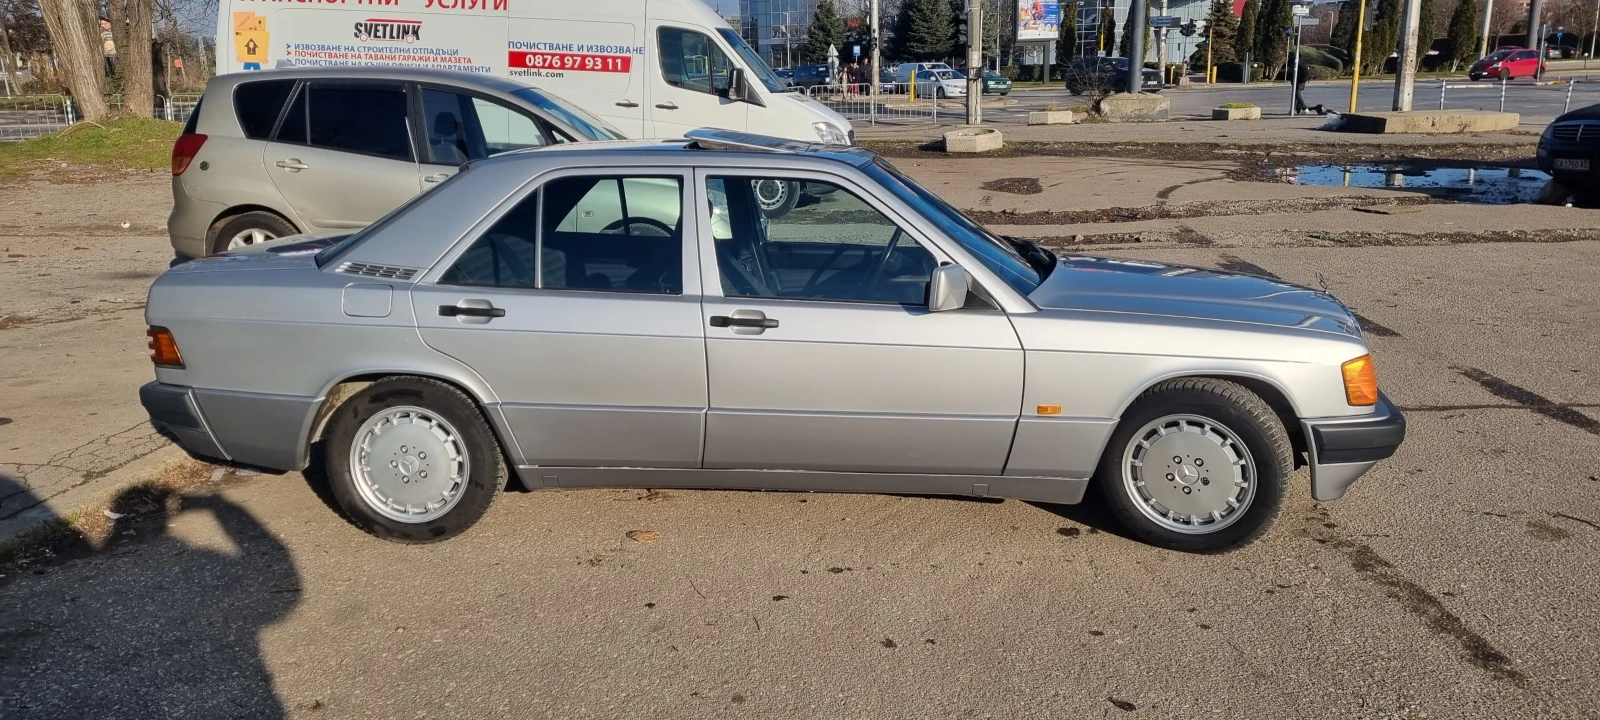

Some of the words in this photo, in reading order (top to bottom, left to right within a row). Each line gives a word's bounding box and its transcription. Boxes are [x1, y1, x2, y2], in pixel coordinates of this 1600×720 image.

[354, 22, 421, 40] SVETLINK
[294, 43, 342, 52] ИЗВОЗВАНЕ
[344, 45, 355, 53] НА
[357, 46, 411, 55] СТРОИТЕЛНИ
[412, 47, 459, 56] ОТПАДЪЦИ
[508, 41, 574, 52] ПОЧИСТВАНЕ
[577, 44, 584, 52] И
[586, 44, 644, 55] ИЗВОЗВАНЕ
[294, 50, 349, 60] ПОЧИСТВАНЕ
[364, 53, 397, 61] ТАВАНИ
[398, 55, 431, 63] ГАРАЖИ
[440, 56, 472, 64] МАЗЕТА
[525, 54, 561, 68] 0876
[564, 56, 582, 69] 97
[585, 57, 602, 70] 93
[606, 58, 622, 71] 11
[509, 68, 564, 78] svetlink.com
